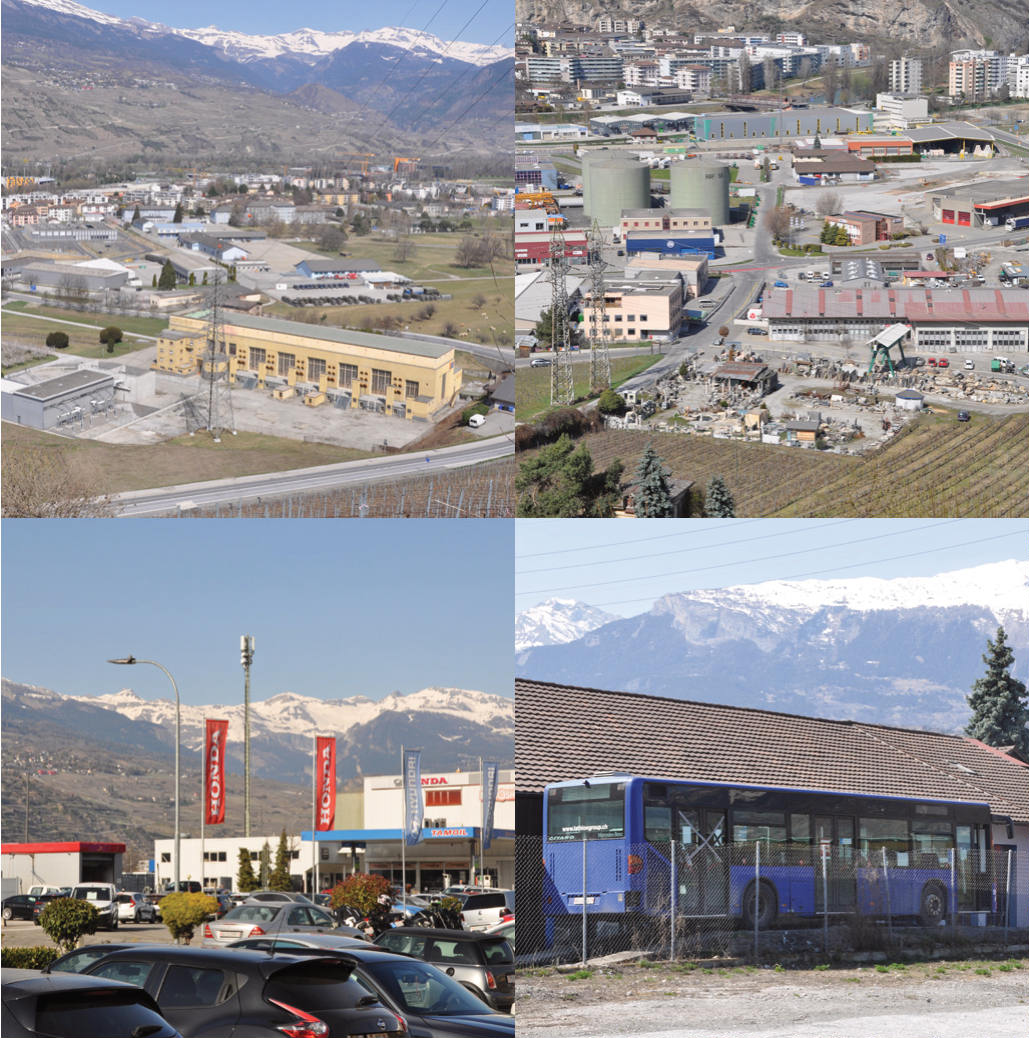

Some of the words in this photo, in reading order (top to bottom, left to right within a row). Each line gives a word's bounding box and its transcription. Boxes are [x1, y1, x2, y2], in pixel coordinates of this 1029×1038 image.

[208, 730, 221, 816] HONDA
[320, 745, 332, 825] HONDA
[420, 777, 448, 786] NDA
[431, 829, 468, 837] TAMOIL
